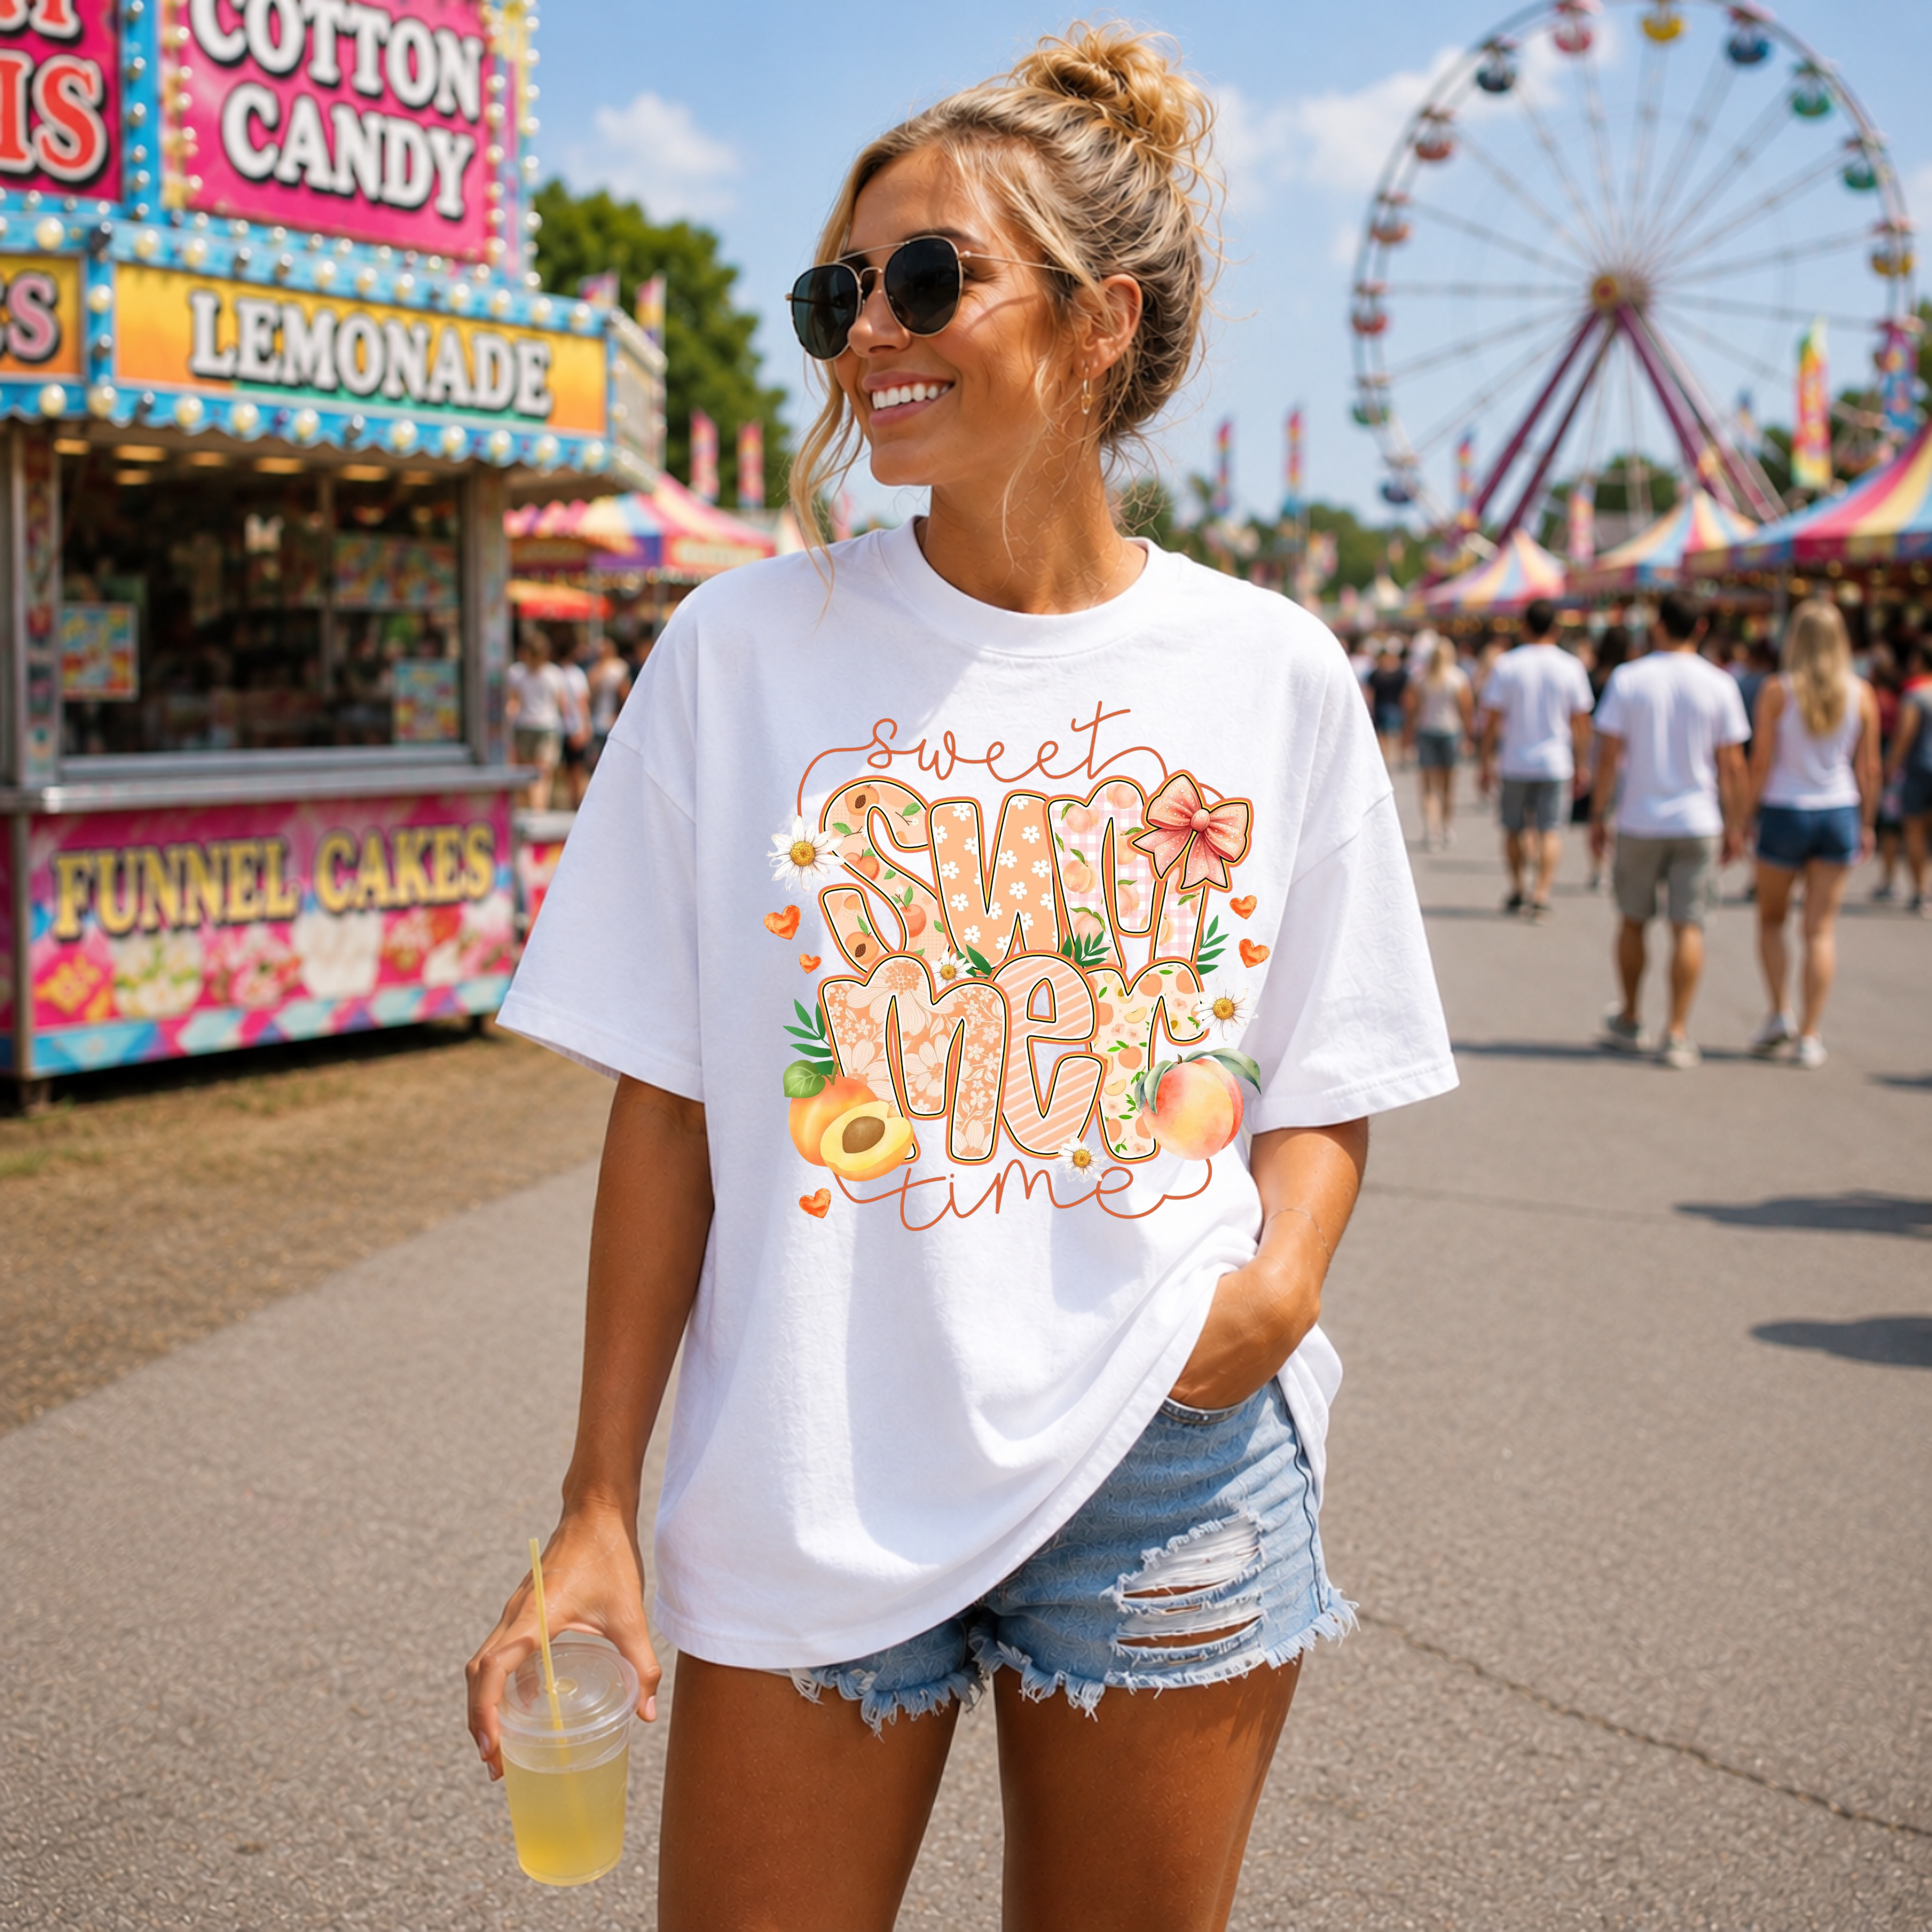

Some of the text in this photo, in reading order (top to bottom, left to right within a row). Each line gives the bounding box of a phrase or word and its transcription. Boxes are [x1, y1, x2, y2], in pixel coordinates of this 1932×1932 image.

[188, 0, 484, 122] COTTON
[221, 82, 476, 219] CANDY
[0, 270, 57, 360] S
[189, 291, 552, 418] LEMONADE
[863, 699, 1132, 781] sweet
[52, 823, 496, 941] FUNNEL CAKES
[900, 1158, 1163, 1232] time
